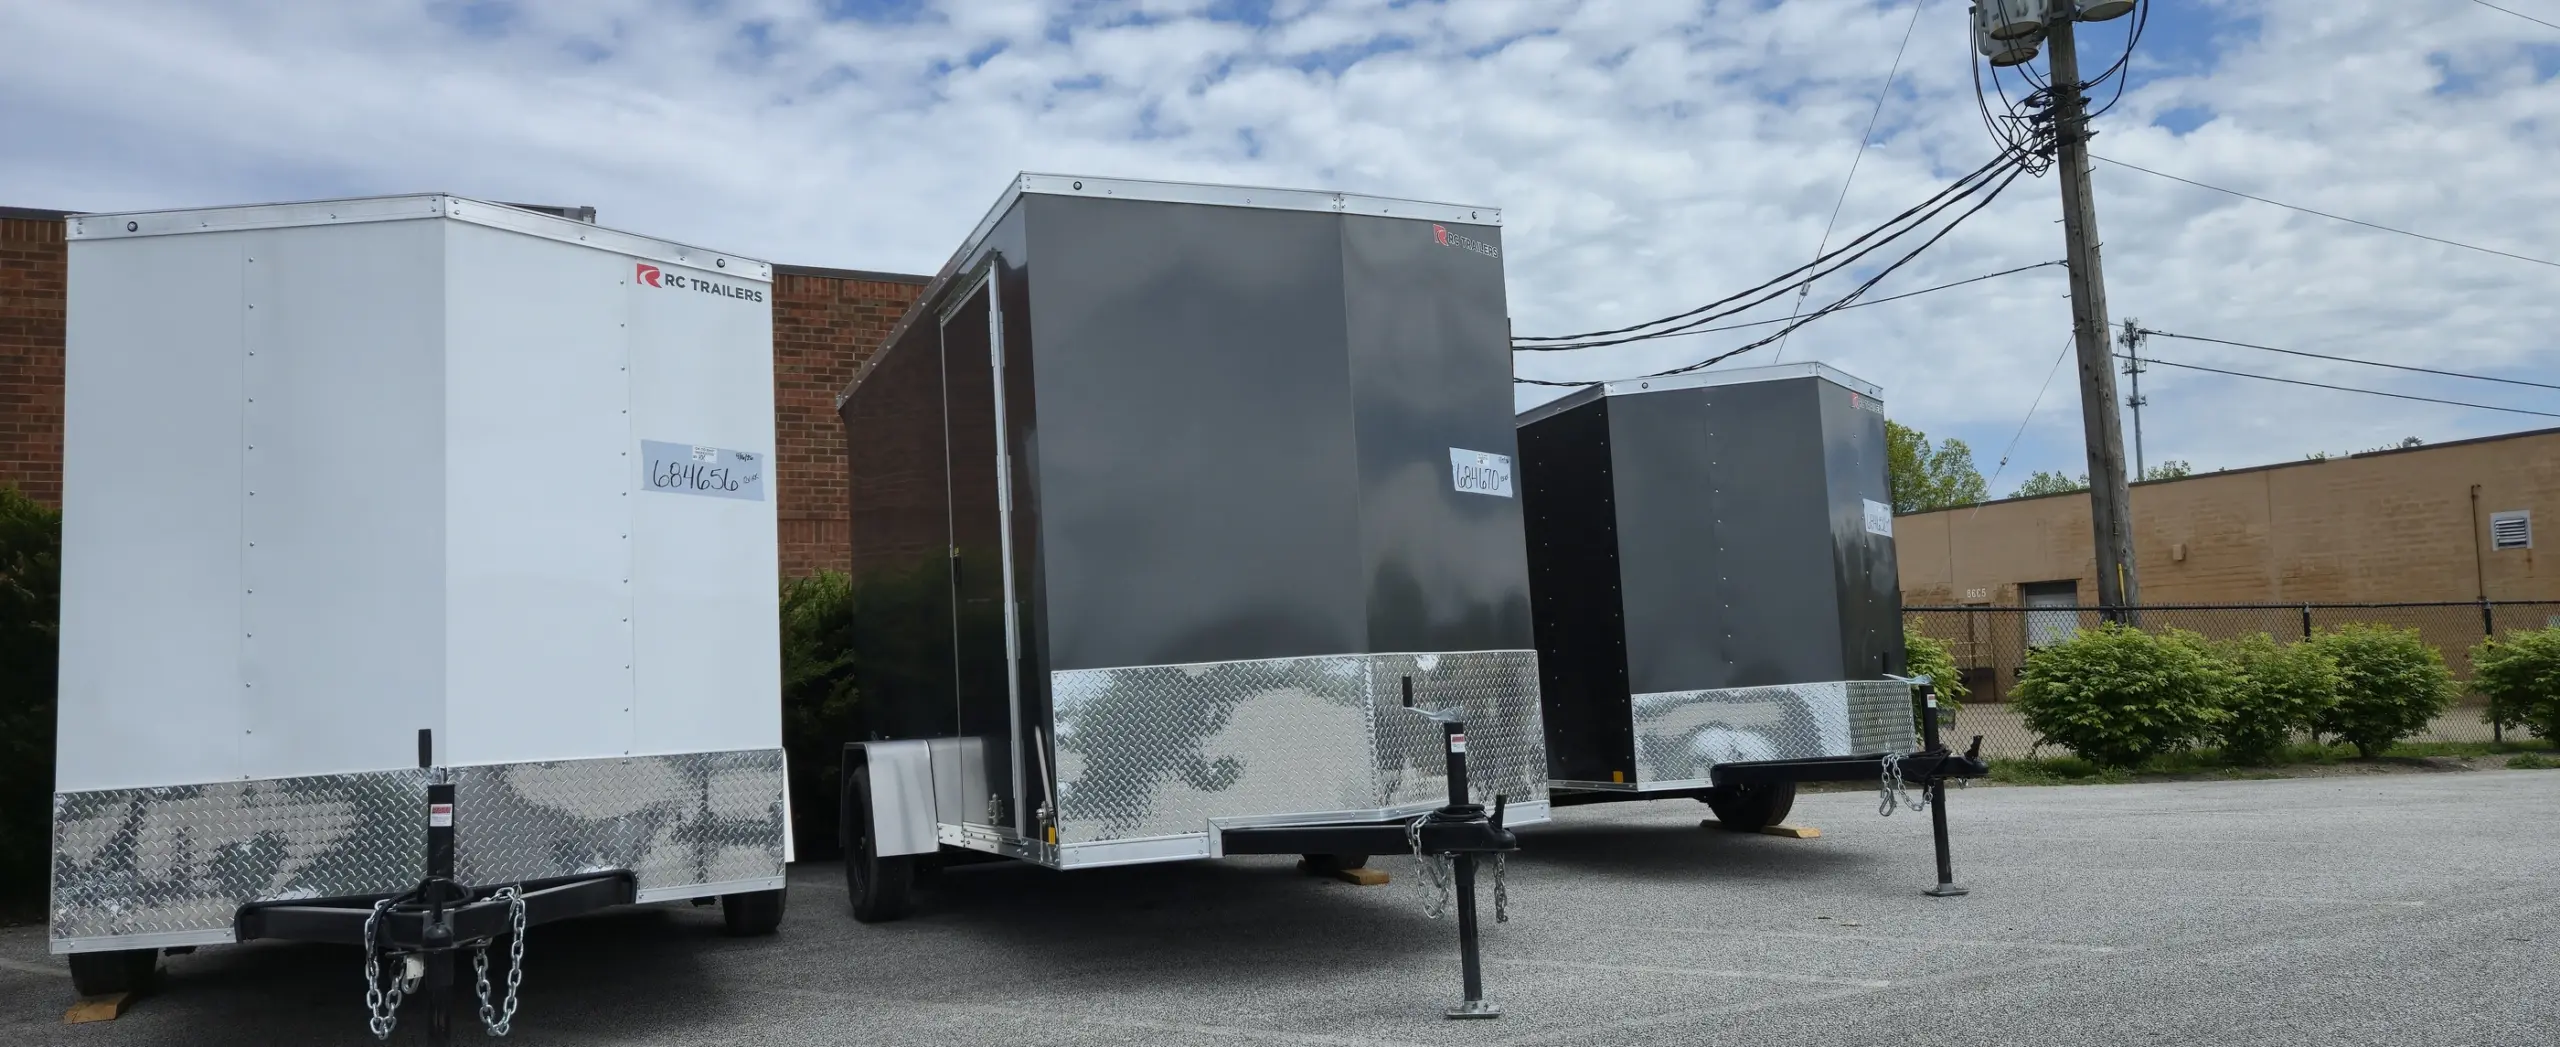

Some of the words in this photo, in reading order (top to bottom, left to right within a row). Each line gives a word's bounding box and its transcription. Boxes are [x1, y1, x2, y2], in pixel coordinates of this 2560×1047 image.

[1448, 232, 1459, 246] RC
[1461, 236, 1498, 258] TRAILERS
[665, 273, 686, 288] RC
[690, 278, 763, 303] TRAILERS
[653, 459, 739, 491] 684656
[1456, 462, 1500, 491] 684670
